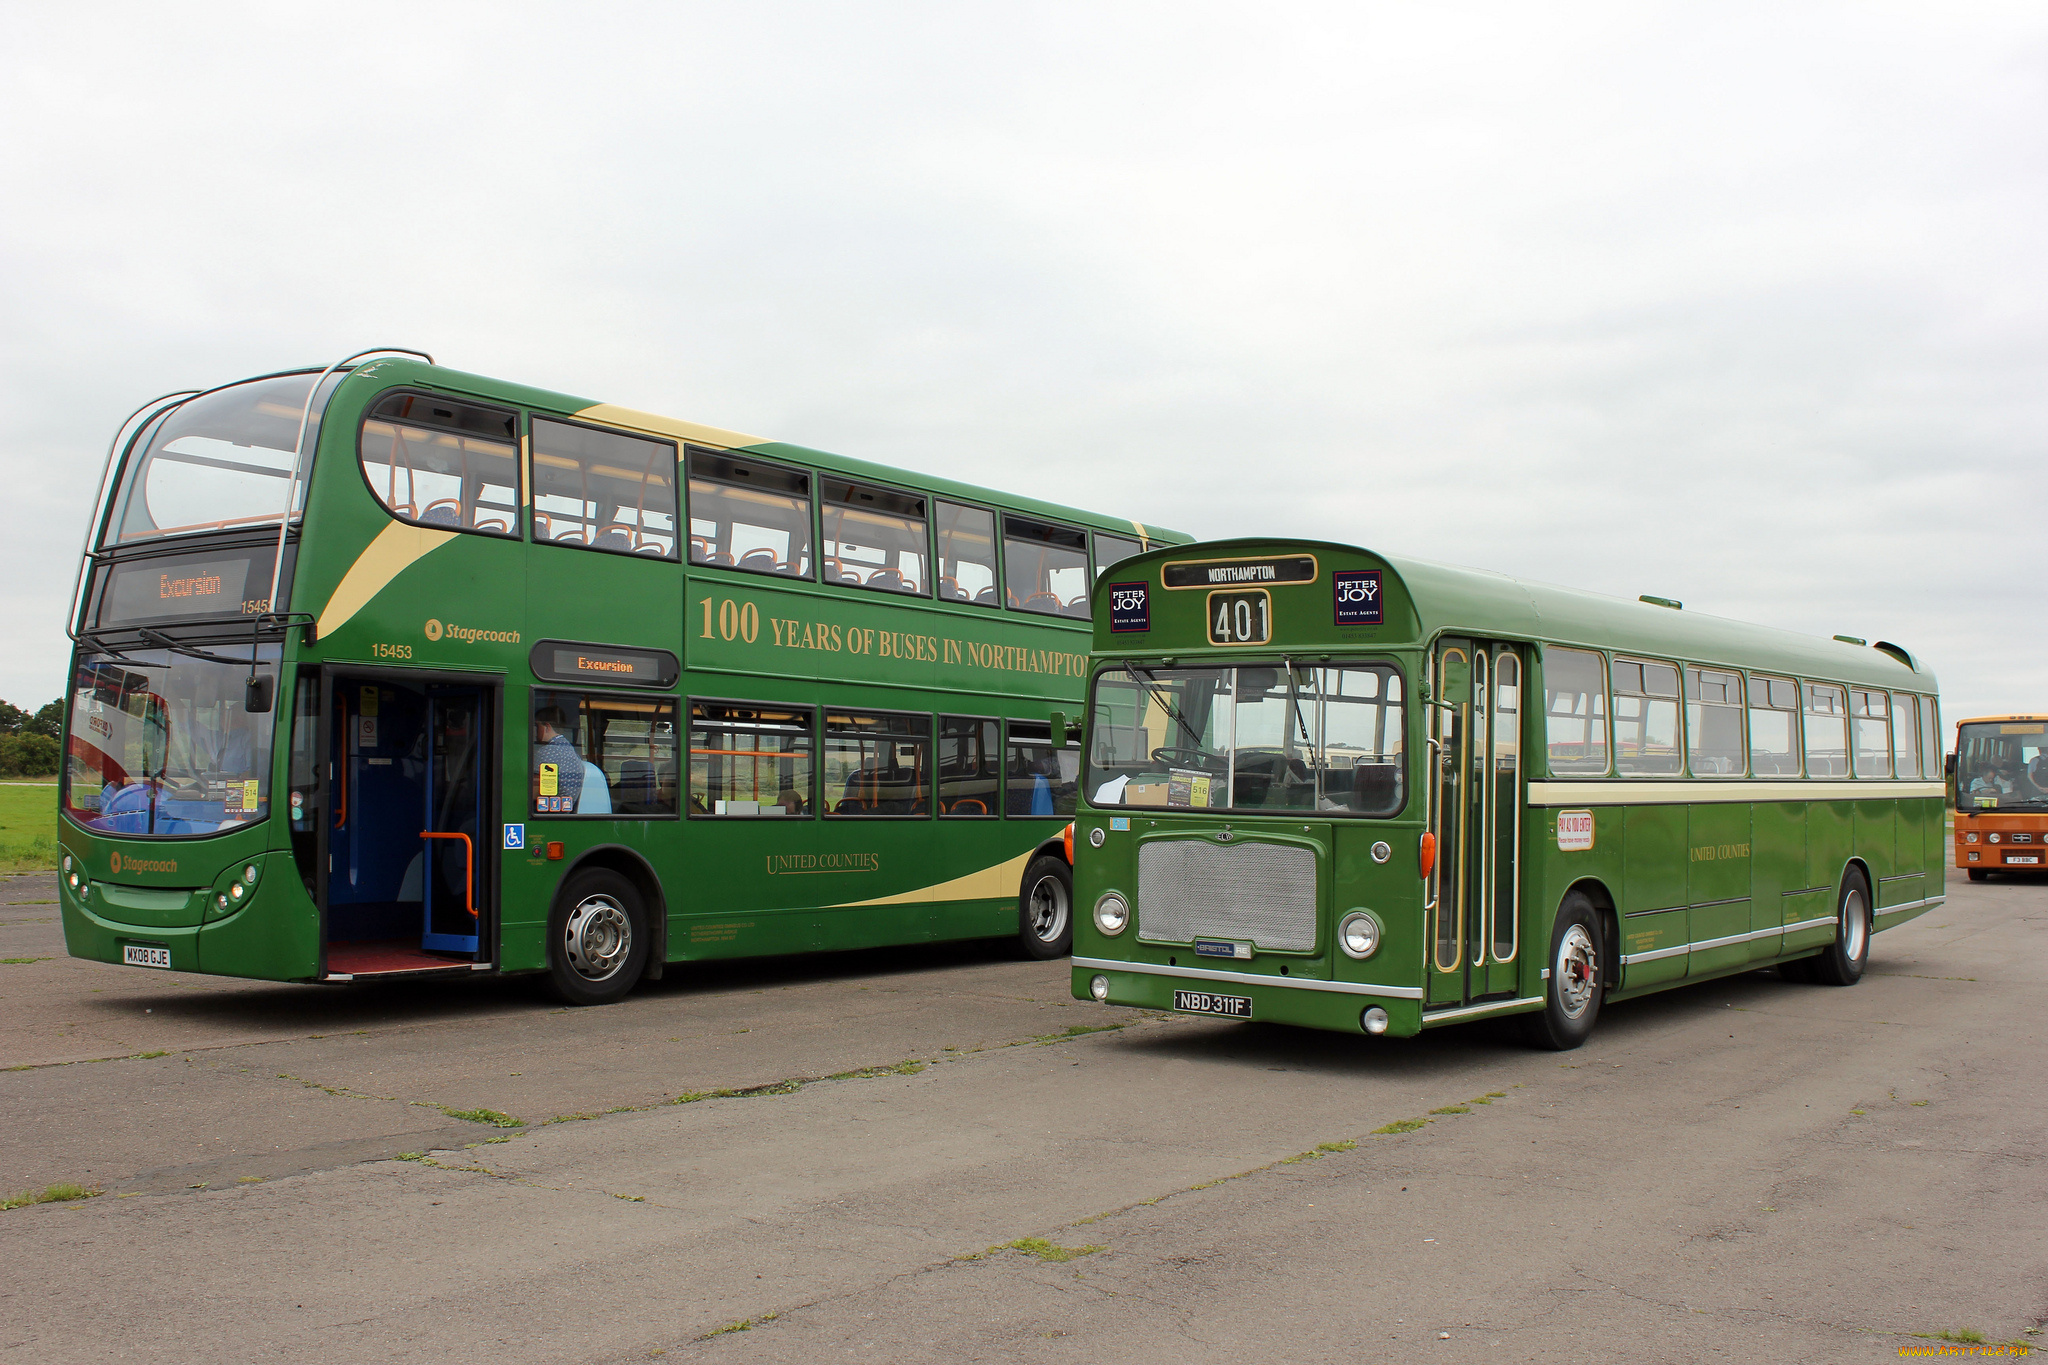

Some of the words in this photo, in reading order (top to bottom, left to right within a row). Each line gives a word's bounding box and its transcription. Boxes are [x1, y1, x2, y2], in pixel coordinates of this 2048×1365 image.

[1208, 565, 1275, 582] NORTHAMPTON
[160, 570, 220, 598] Excursion
[1337, 580, 1378, 590] PETER
[1112, 590, 1145, 598] PETER
[1338, 588, 1378, 602] JOY
[1113, 598, 1145, 610] JOY
[1215, 598, 1268, 642] 401
[445, 623, 521, 644] Stagecoach
[699, 597, 759, 644] 100
[770, 618, 842, 652] YEARS
[847, 627, 875, 655] OF
[878, 630, 938, 662] BUSES
[943, 638, 963, 665] IN
[372, 644, 412, 659] 15453
[578, 656, 633, 672] Excursion
[245, 788, 257, 797] 514
[1192, 786, 1208, 794] 516
[1580, 818, 1591, 832] ENTER
[1690, 846, 1716, 862] UNITED
[1718, 843, 1750, 860] COUNTIES
[122, 855, 178, 875] Stagecoach
[766, 854, 817, 874] UNITED
[819, 853, 879, 872] COUNTIES
[128, 947, 149, 963] MX08
[151, 949, 168, 965] GJE
[1199, 944, 1232, 953] BRISTOL
[1181, 992, 1211, 1010] NBD
[1213, 996, 1245, 1014] 311F
